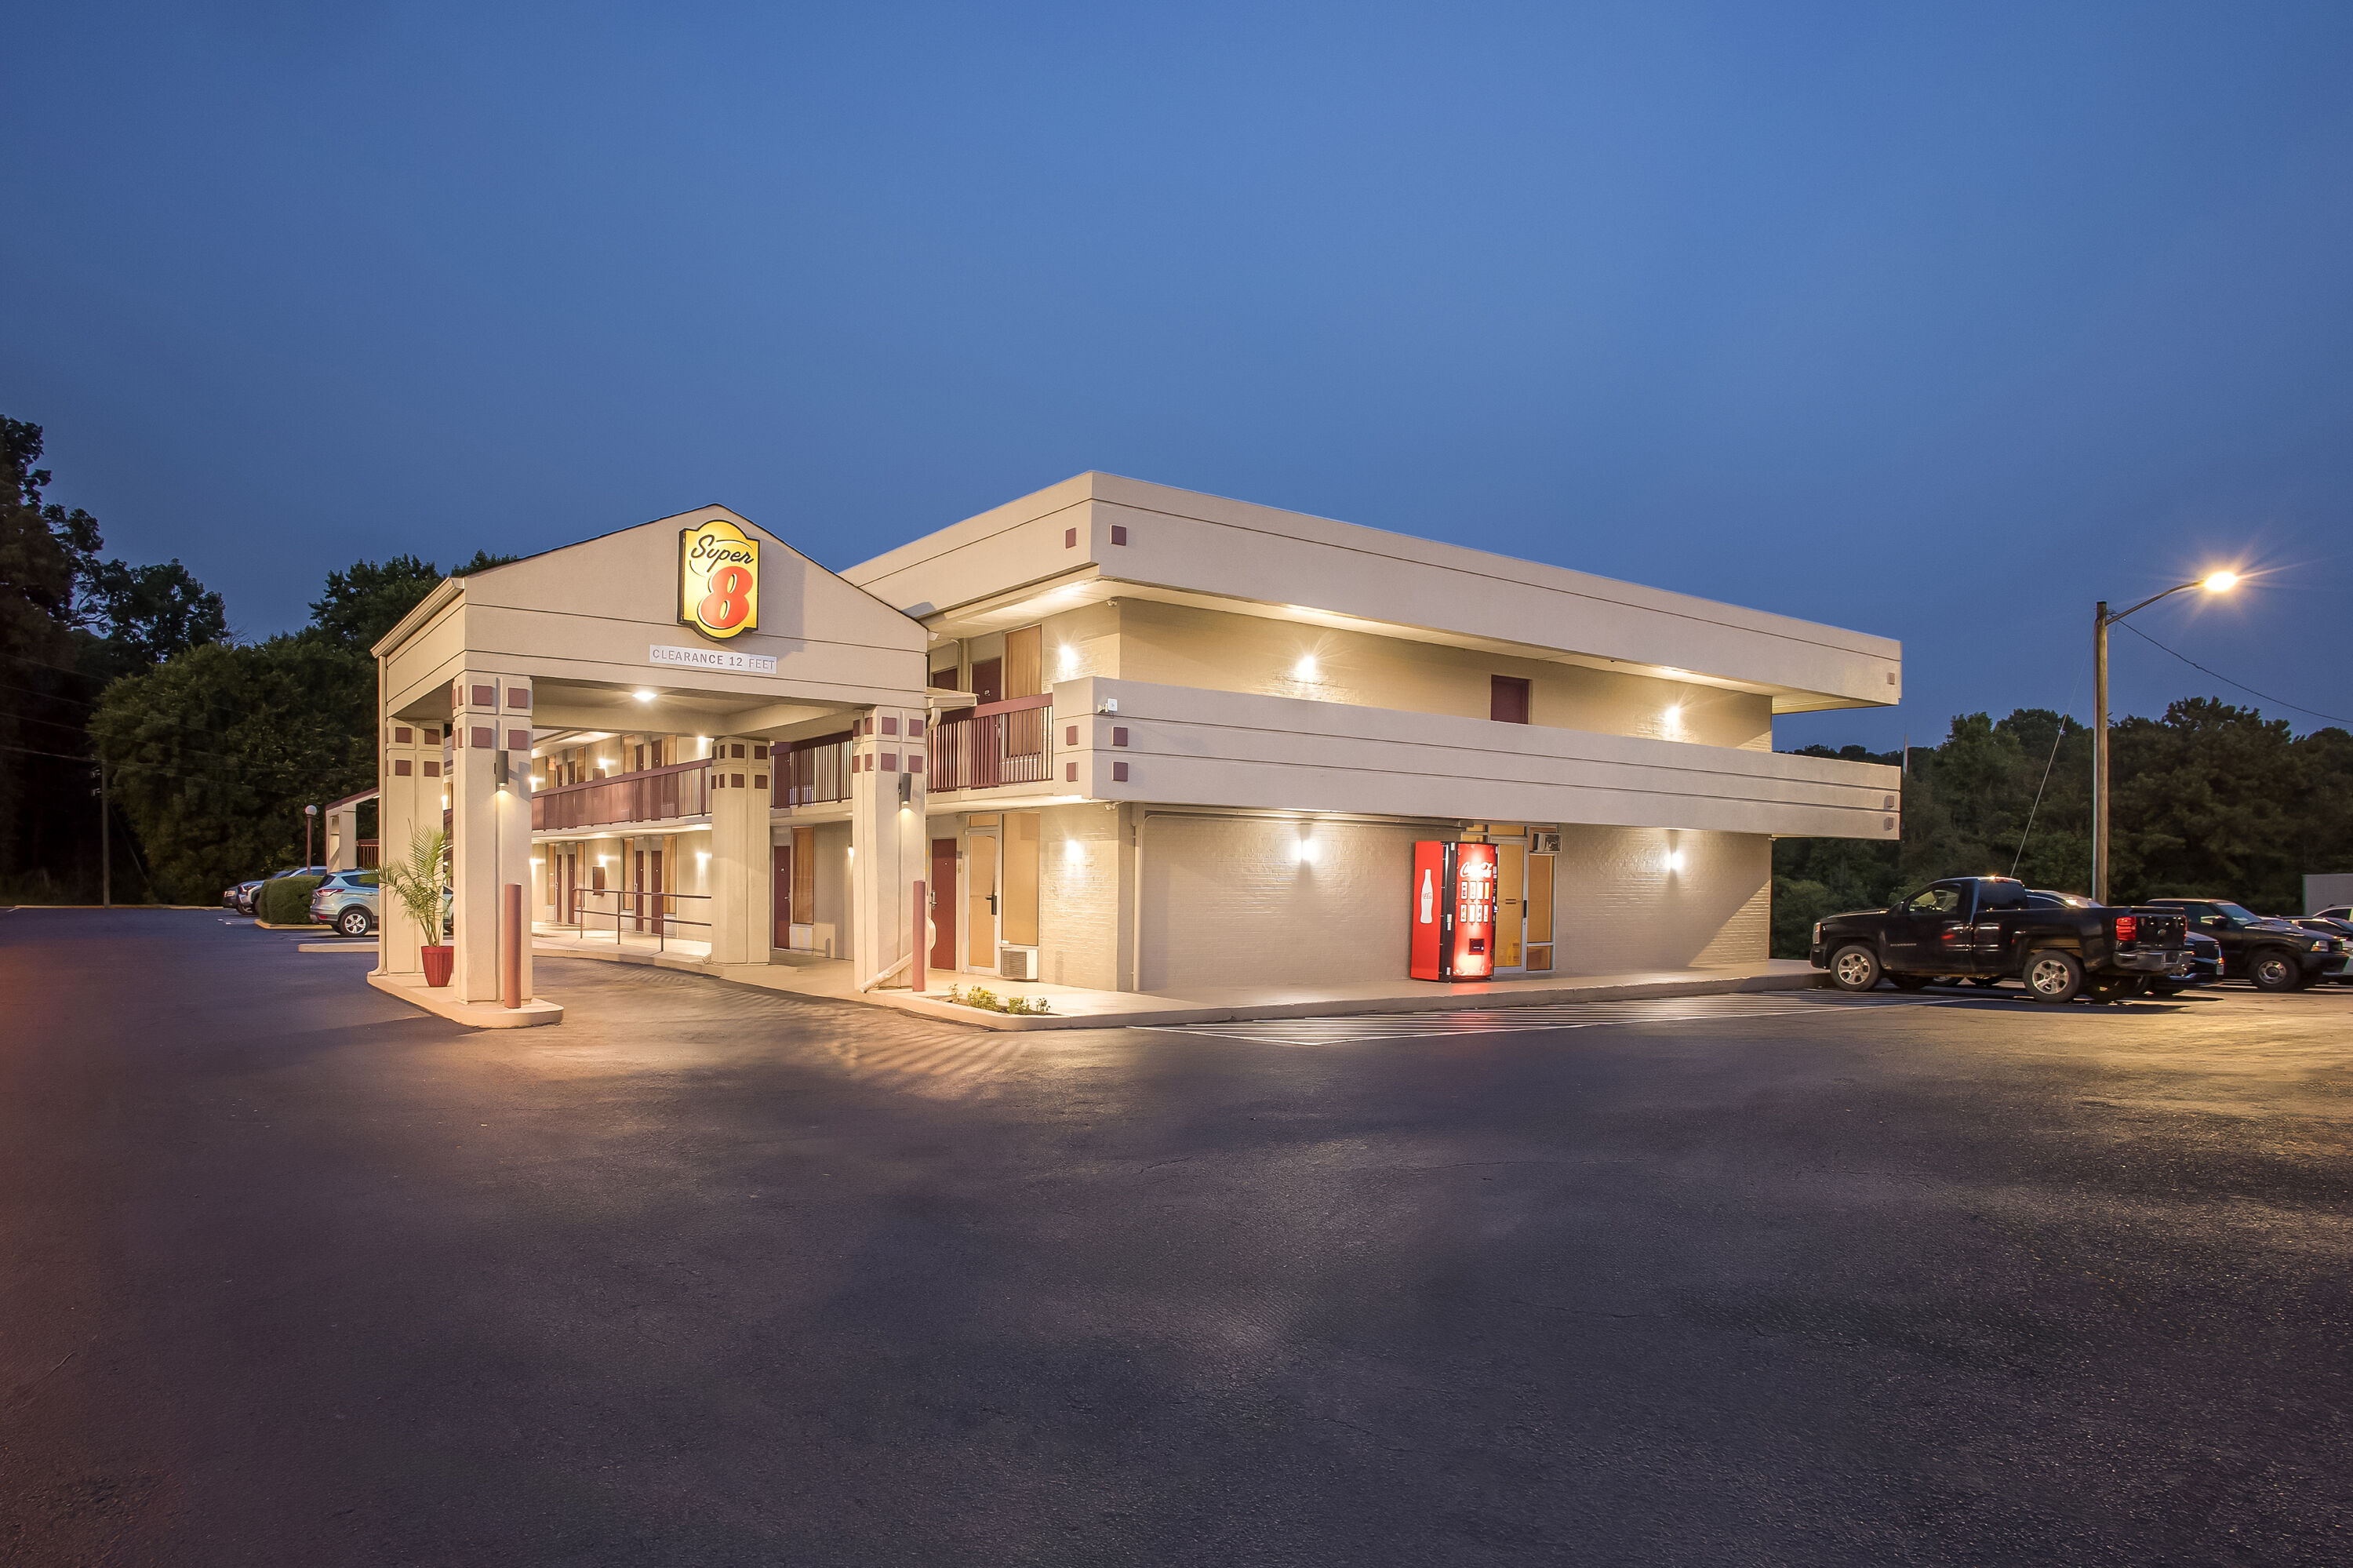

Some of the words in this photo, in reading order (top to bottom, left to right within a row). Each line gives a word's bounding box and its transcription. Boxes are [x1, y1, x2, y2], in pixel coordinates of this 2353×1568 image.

[690, 534, 754, 573] Super
[697, 566, 754, 629] 8
[653, 649, 724, 665] CLEARANCE
[729, 657, 743, 667] 12
[748, 658, 775, 670] FEET
